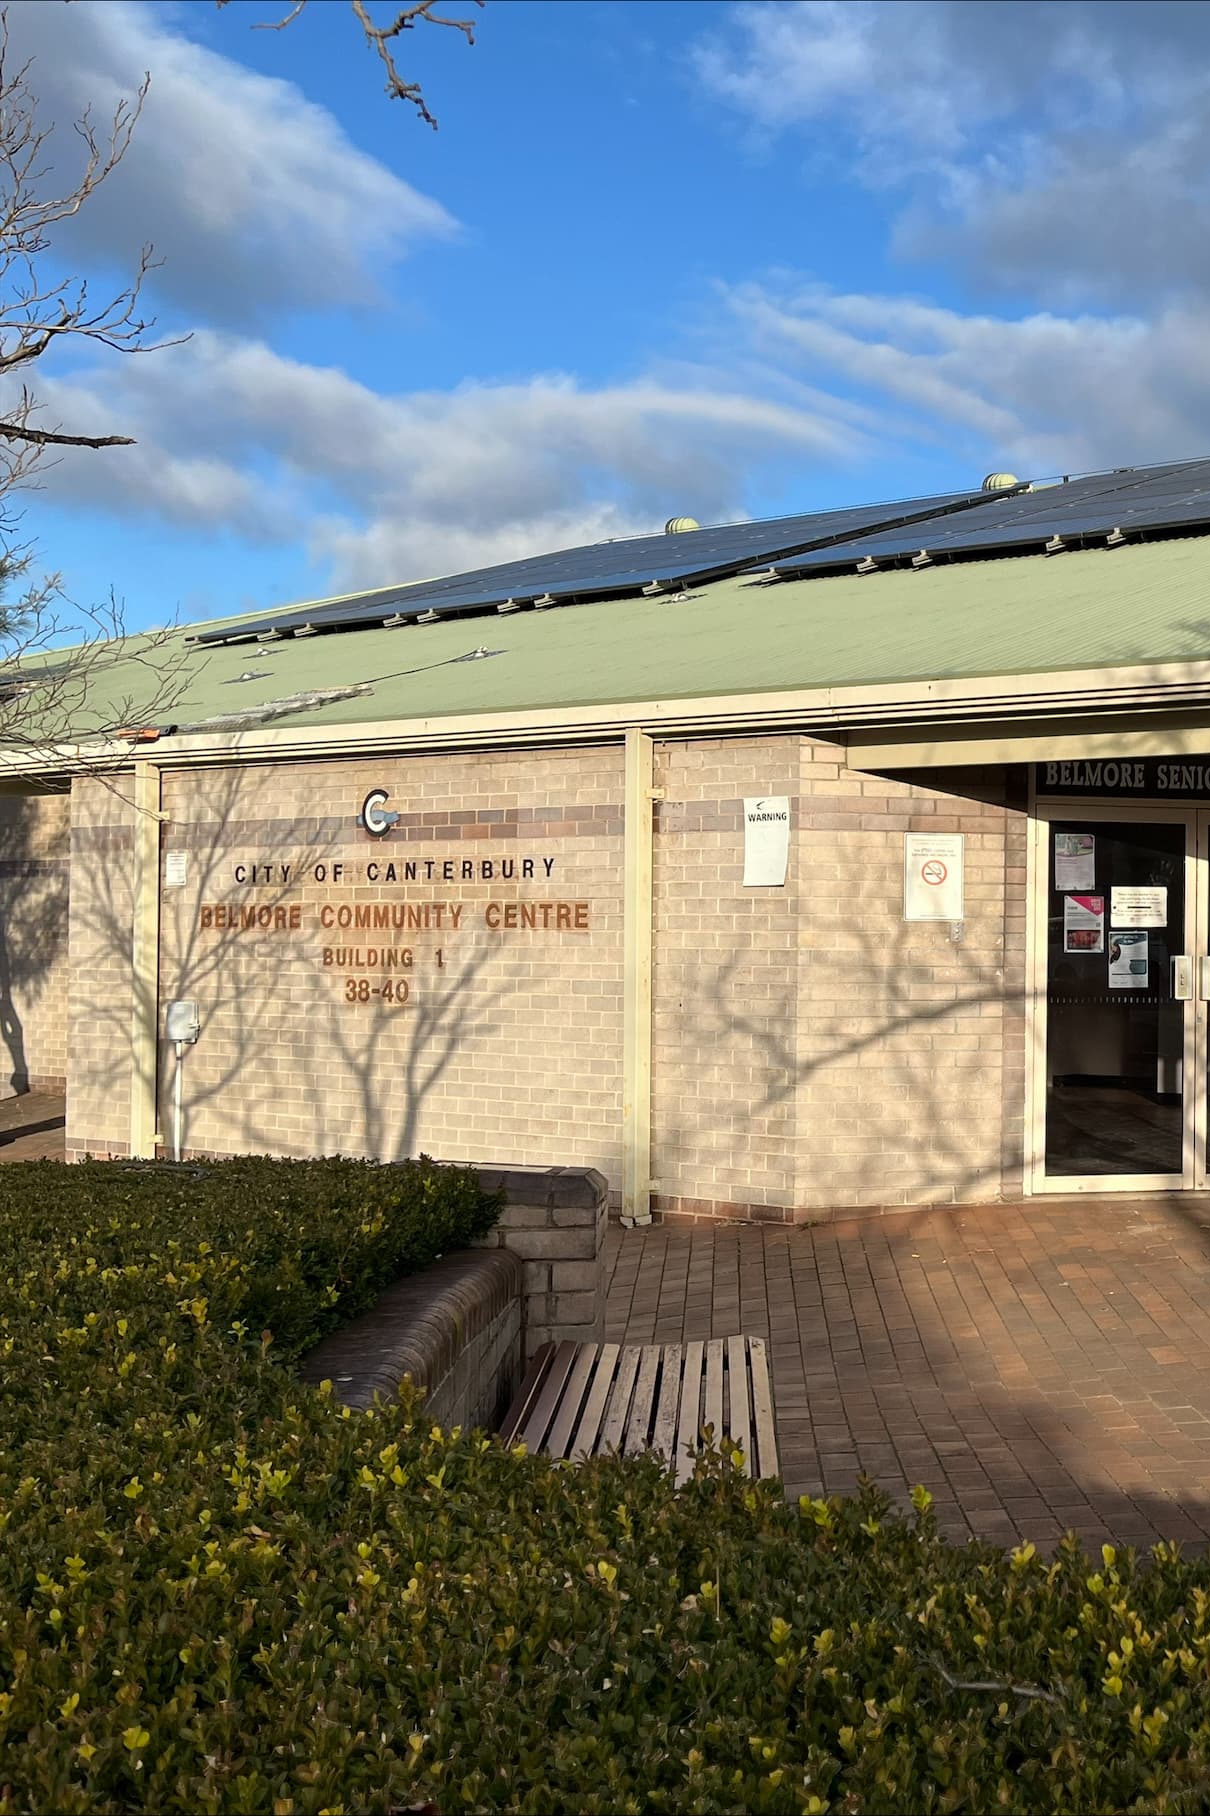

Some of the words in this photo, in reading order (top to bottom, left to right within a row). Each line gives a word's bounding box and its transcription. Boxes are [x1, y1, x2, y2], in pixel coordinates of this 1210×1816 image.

[1045, 762, 1145, 788] BELMORE
[747, 811, 787, 822] WARNING
[235, 865, 290, 882] CITY
[315, 864, 343, 882] OF
[367, 858, 554, 881] CANTERBURY
[200, 905, 302, 928] BELMORE
[320, 904, 463, 929] COMMUNITY
[485, 903, 589, 928] CENTRE
[322, 948, 413, 968] BUILDING
[435, 948, 444, 968] 1
[345, 979, 409, 1003] 38-40
